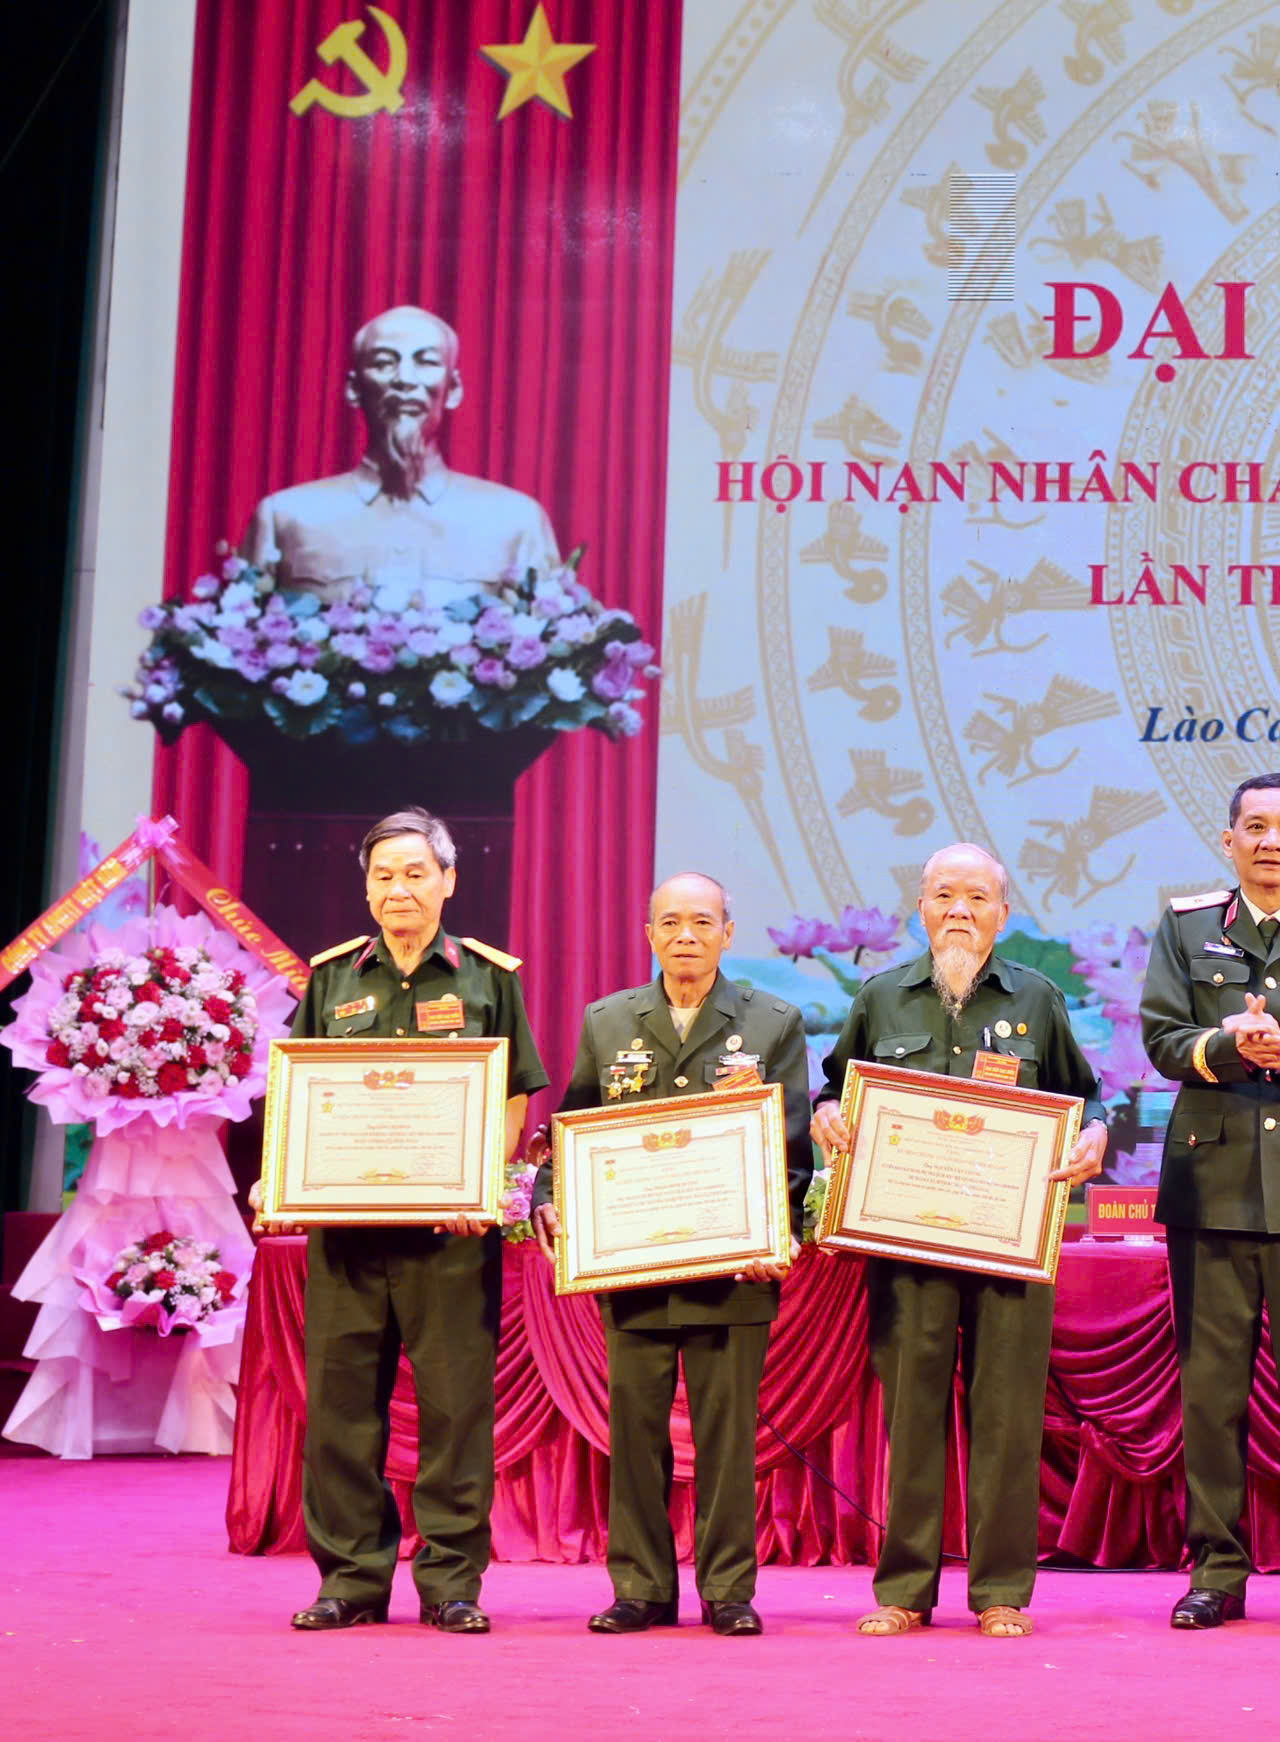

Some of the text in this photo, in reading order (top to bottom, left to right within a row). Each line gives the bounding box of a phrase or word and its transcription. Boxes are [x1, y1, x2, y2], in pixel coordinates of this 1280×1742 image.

[1043, 281, 1255, 383] ĐẠI
[715, 454, 825, 514] HỘI
[845, 461, 970, 514] NẠN
[989, 449, 1160, 503] NHÂN
[1088, 551, 1210, 606] LẦN
[1138, 705, 1226, 744] Lào
[1098, 1199, 1126, 1219] ĐOÀN
[1128, 1198, 1149, 1219] CHỦ
